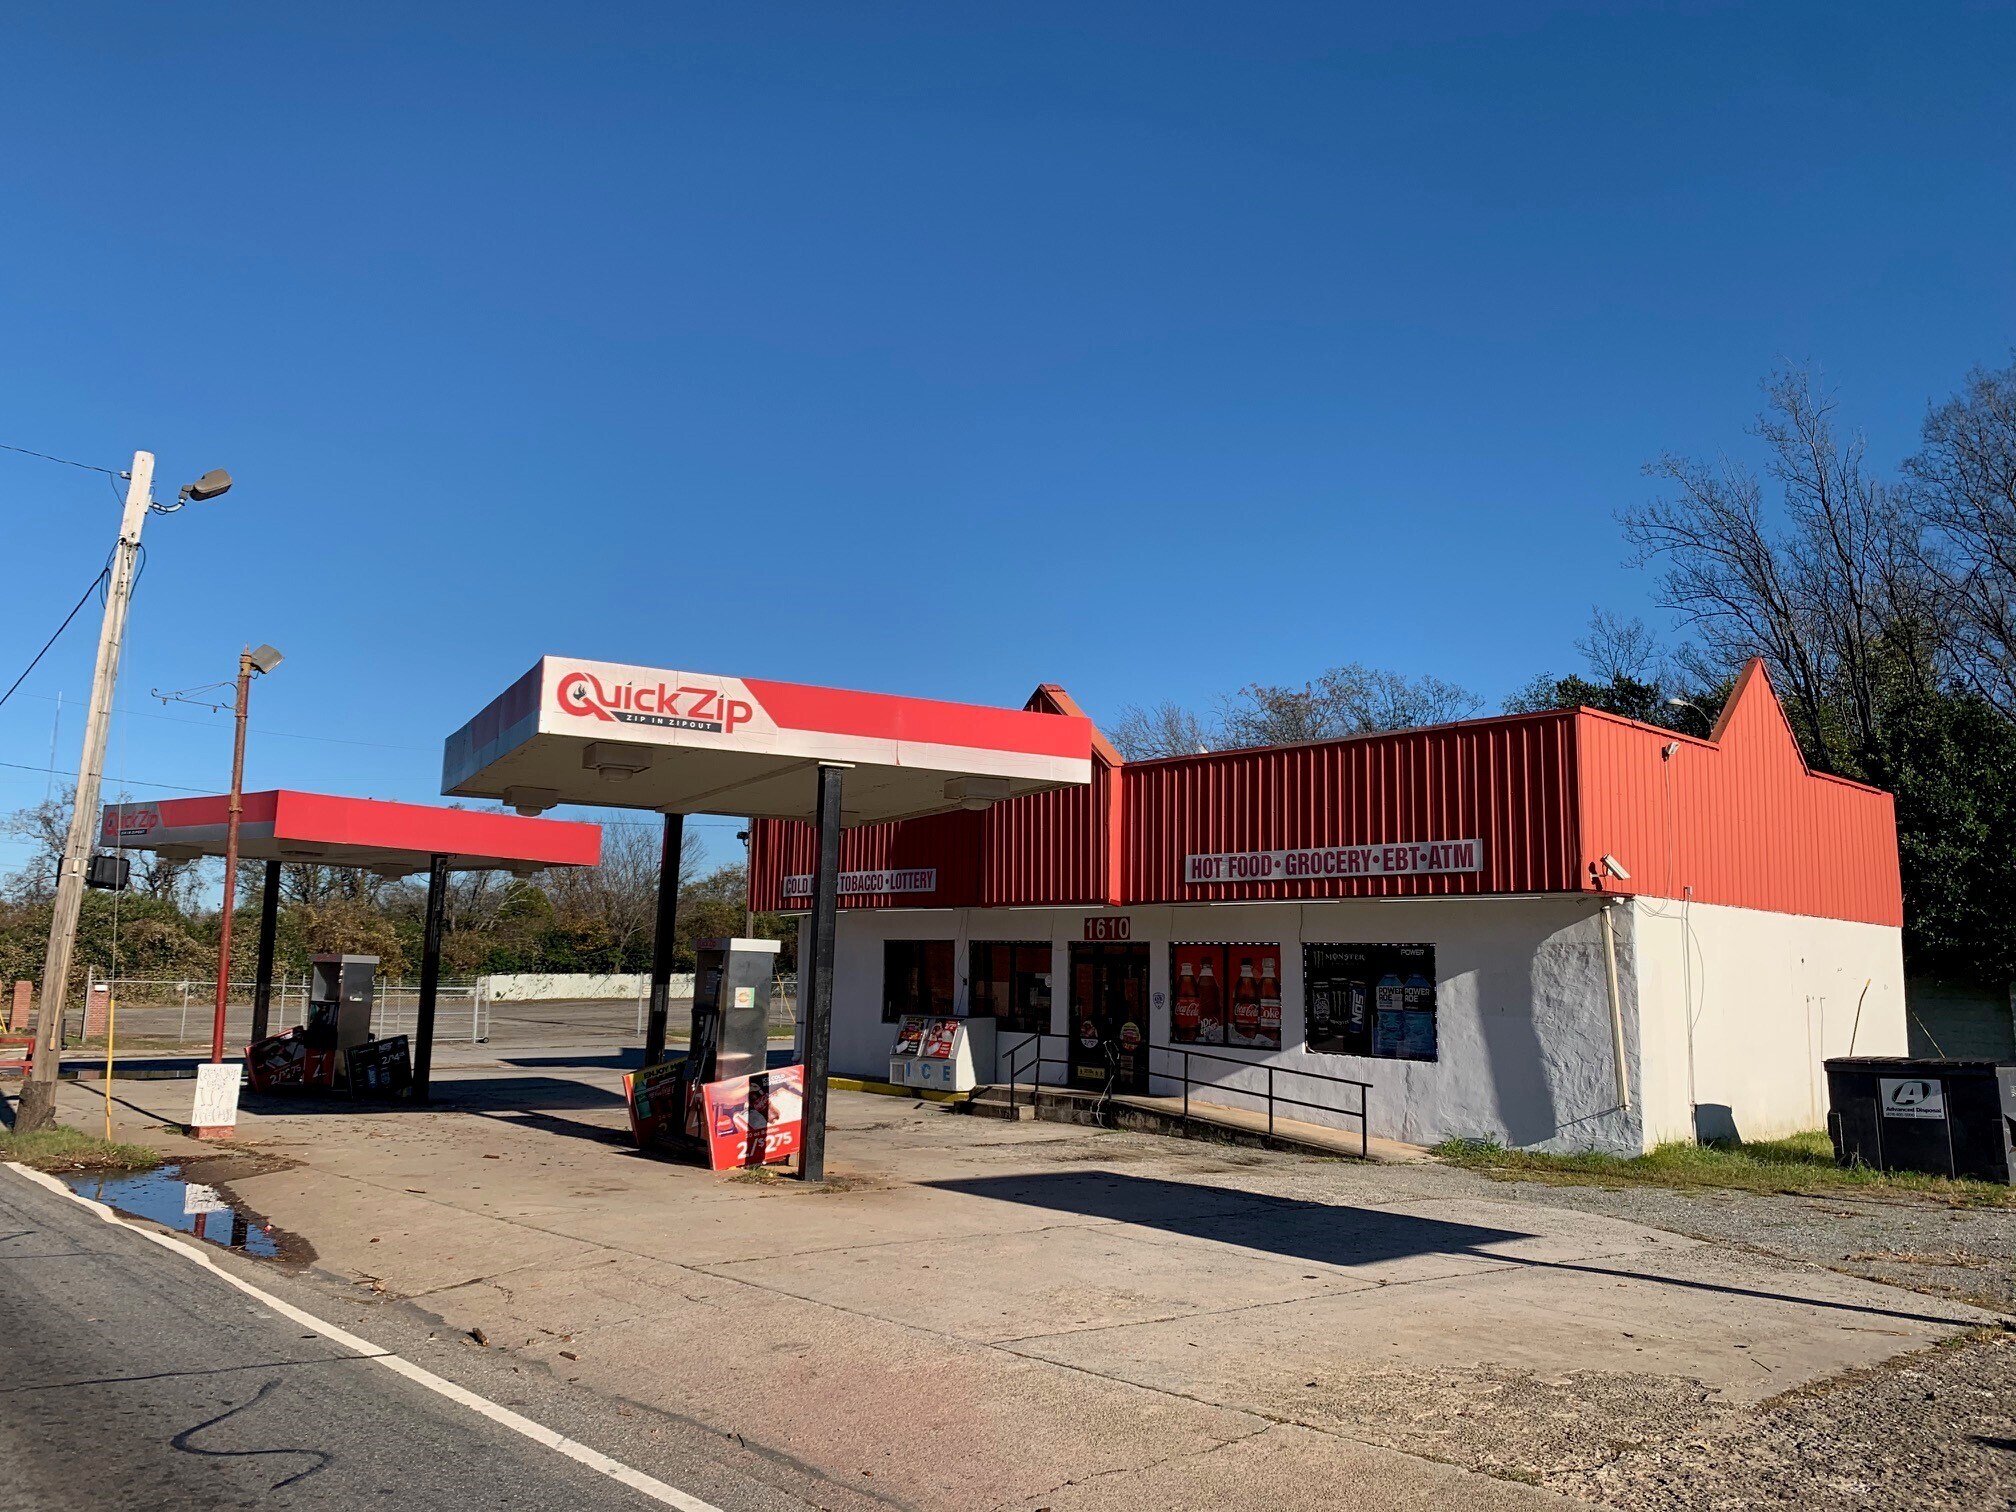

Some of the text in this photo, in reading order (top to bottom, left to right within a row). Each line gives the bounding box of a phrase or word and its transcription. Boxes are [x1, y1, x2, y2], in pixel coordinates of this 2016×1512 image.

[626, 714, 646, 722] ZIP
[1191, 843, 1474, 879] HOT FOOD GROCERY EBT ATM
[786, 878, 808, 894] COLD
[840, 873, 884, 892] TOBACCO
[890, 870, 934, 890] LOTTERY
[1086, 918, 1130, 939] 1610
[1325, 953, 1366, 961] MONSTER
[1404, 988, 1430, 996] POWER
[1351, 989, 1364, 1024] NOS
[643, 1066, 669, 1079] ENJOY
[906, 1062, 951, 1081] ICE
